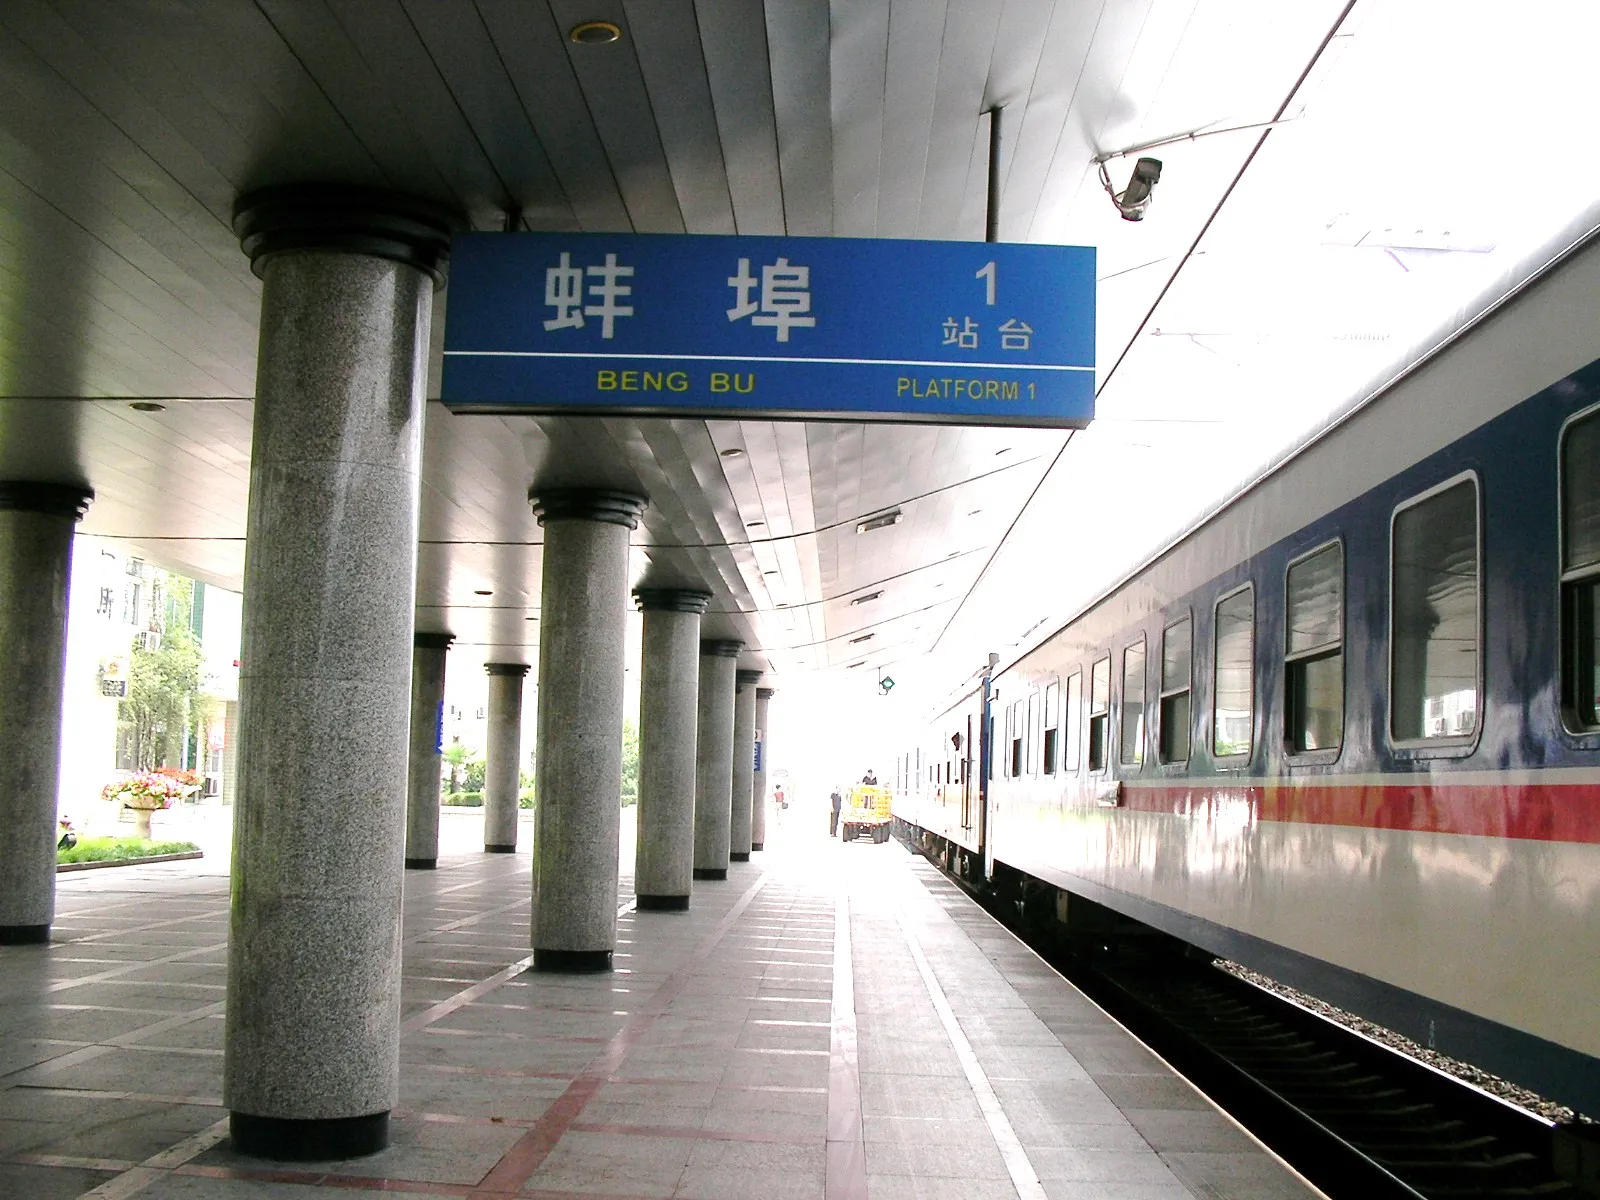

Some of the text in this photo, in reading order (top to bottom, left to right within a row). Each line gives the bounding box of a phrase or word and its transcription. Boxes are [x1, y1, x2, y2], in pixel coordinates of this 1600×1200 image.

[975, 261, 996, 305] 1
[596, 369, 755, 393] BENG BU
[897, 378, 1036, 401] PLATFORM 1
